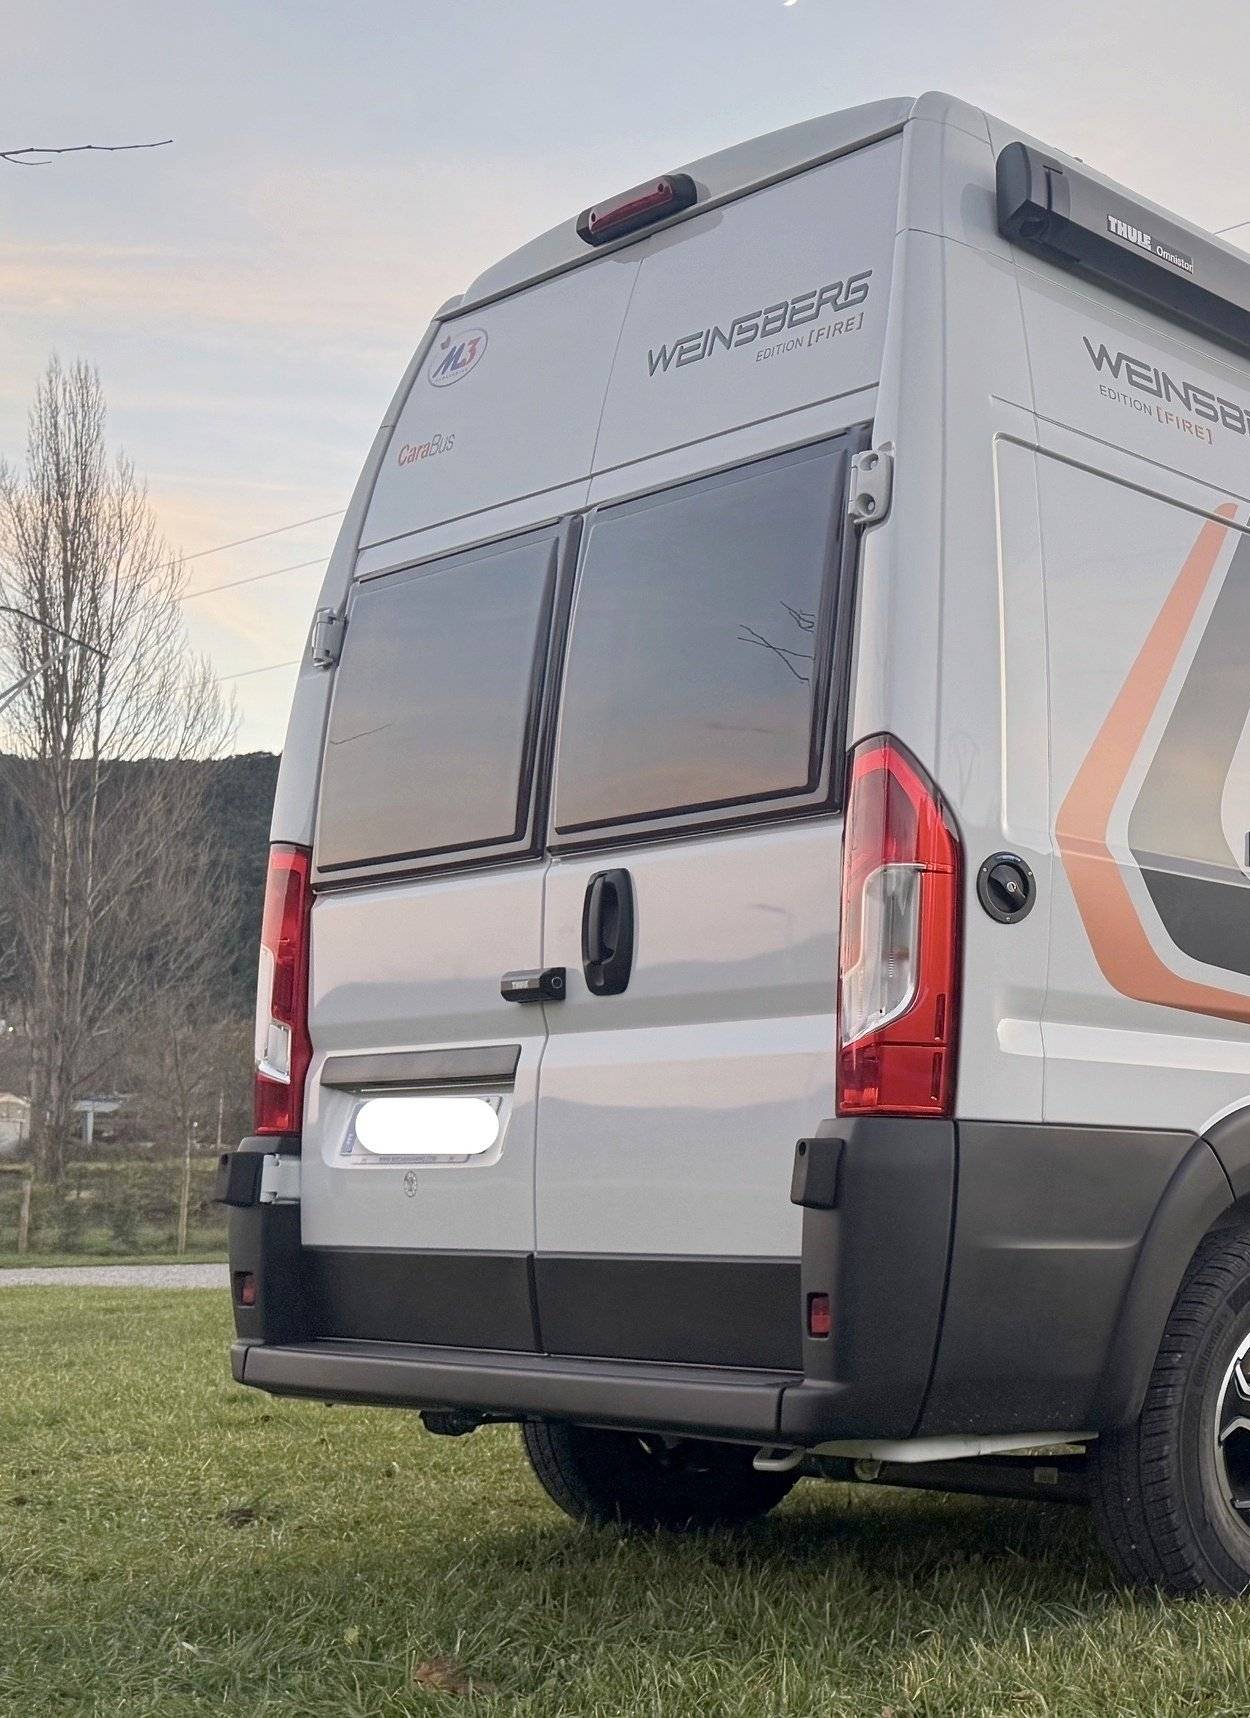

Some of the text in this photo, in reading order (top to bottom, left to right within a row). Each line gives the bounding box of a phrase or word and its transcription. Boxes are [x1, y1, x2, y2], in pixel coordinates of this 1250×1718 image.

[1108, 215, 1193, 272] THULE Omnistor
[648, 269, 873, 377] WEINSBERG
[755, 335, 804, 362] EDITION
[1099, 384, 1153, 416] EDITION
[399, 434, 455, 466] CaraBus
